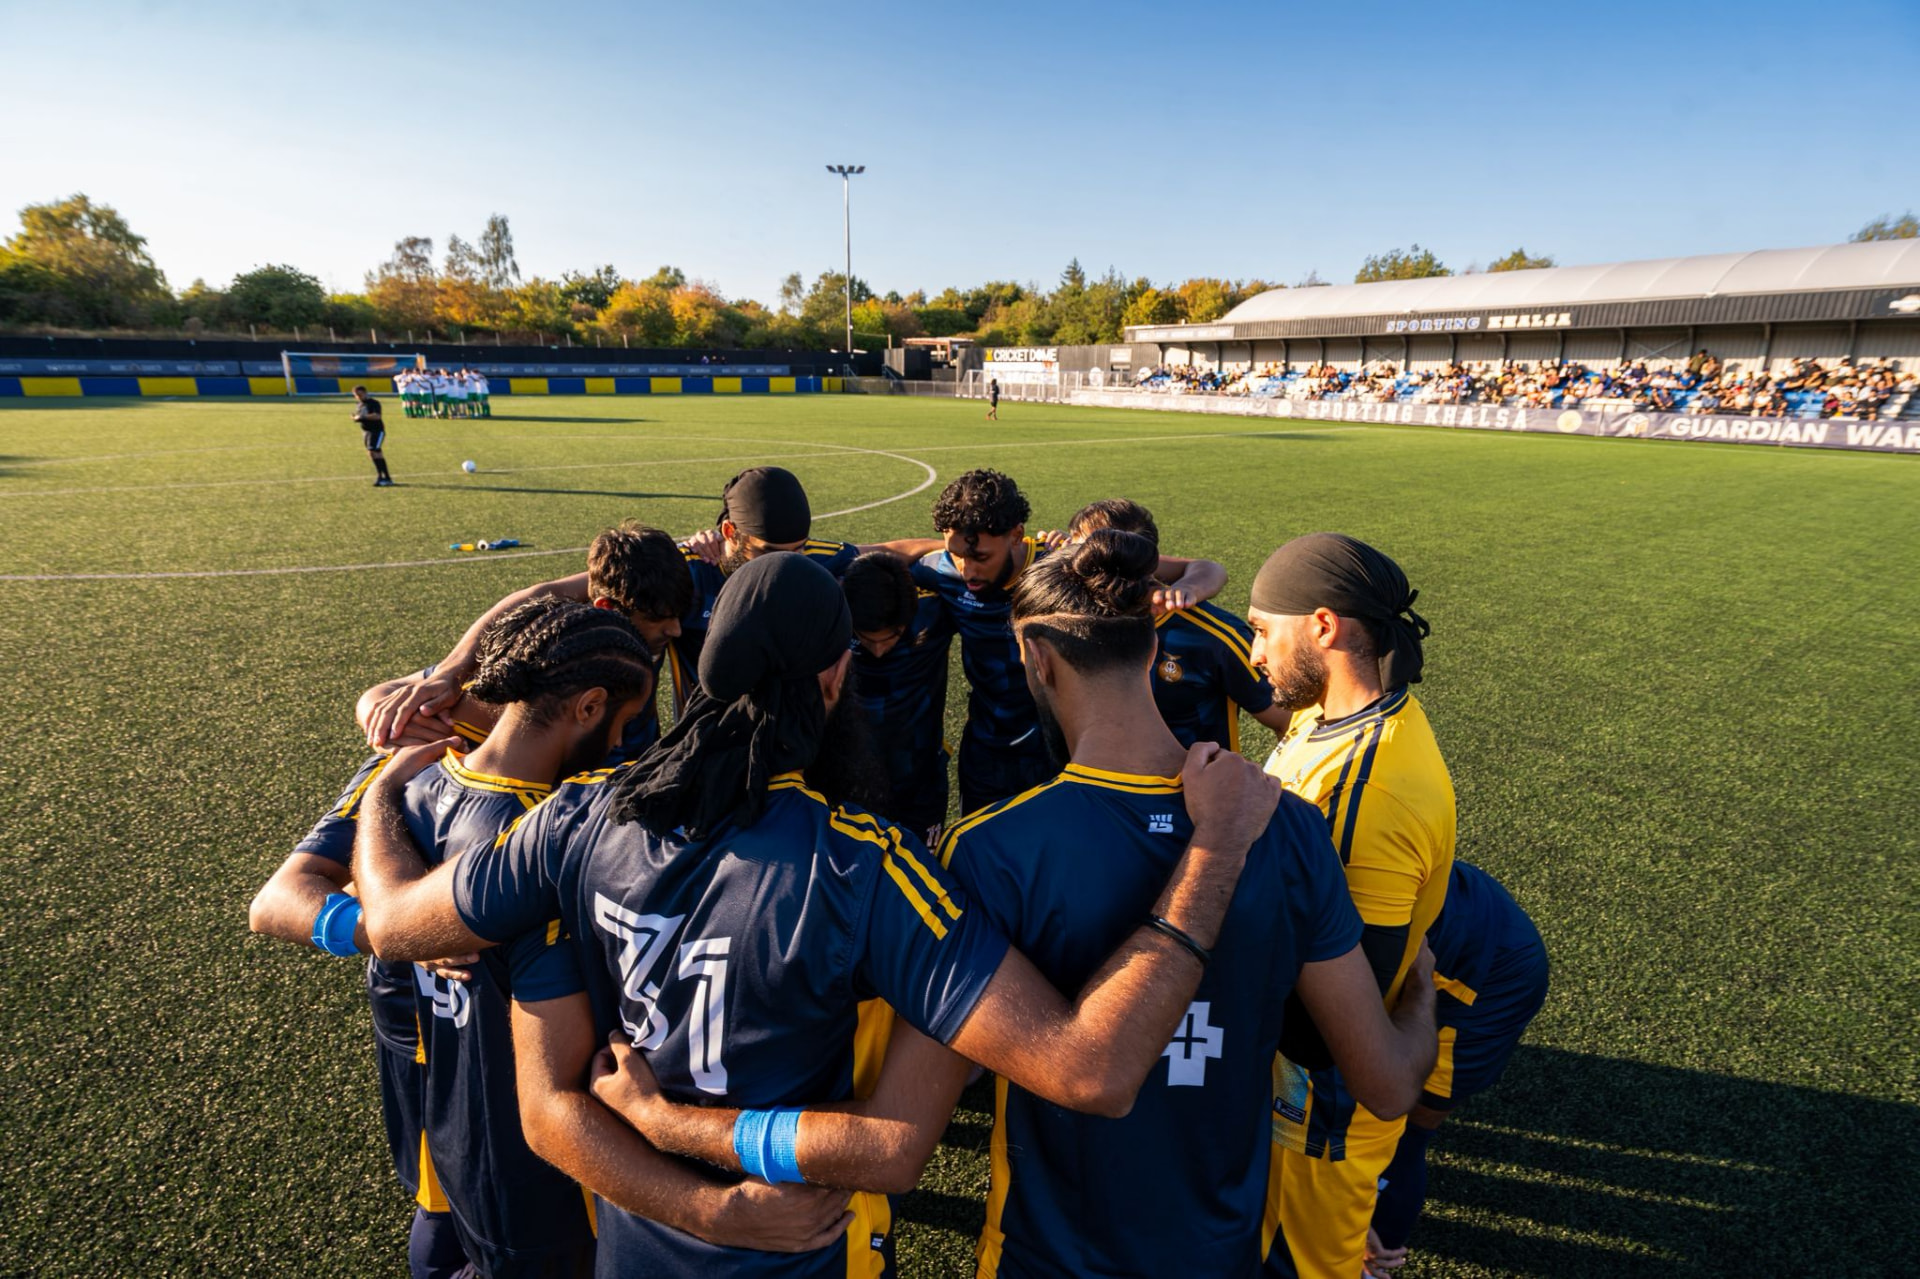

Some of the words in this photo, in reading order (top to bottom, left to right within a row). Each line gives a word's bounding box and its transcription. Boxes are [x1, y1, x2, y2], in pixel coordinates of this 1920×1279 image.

[1386, 316, 1480, 332] SPORTING
[1487, 312, 1571, 329] KHALSA
[994, 348, 1028, 361] CRICKET
[1029, 348, 1057, 361] DOME
[1306, 403, 1413, 422] SPORTING
[1424, 404, 1527, 429] KHALSA
[1670, 417, 1829, 443] GUARDIAN
